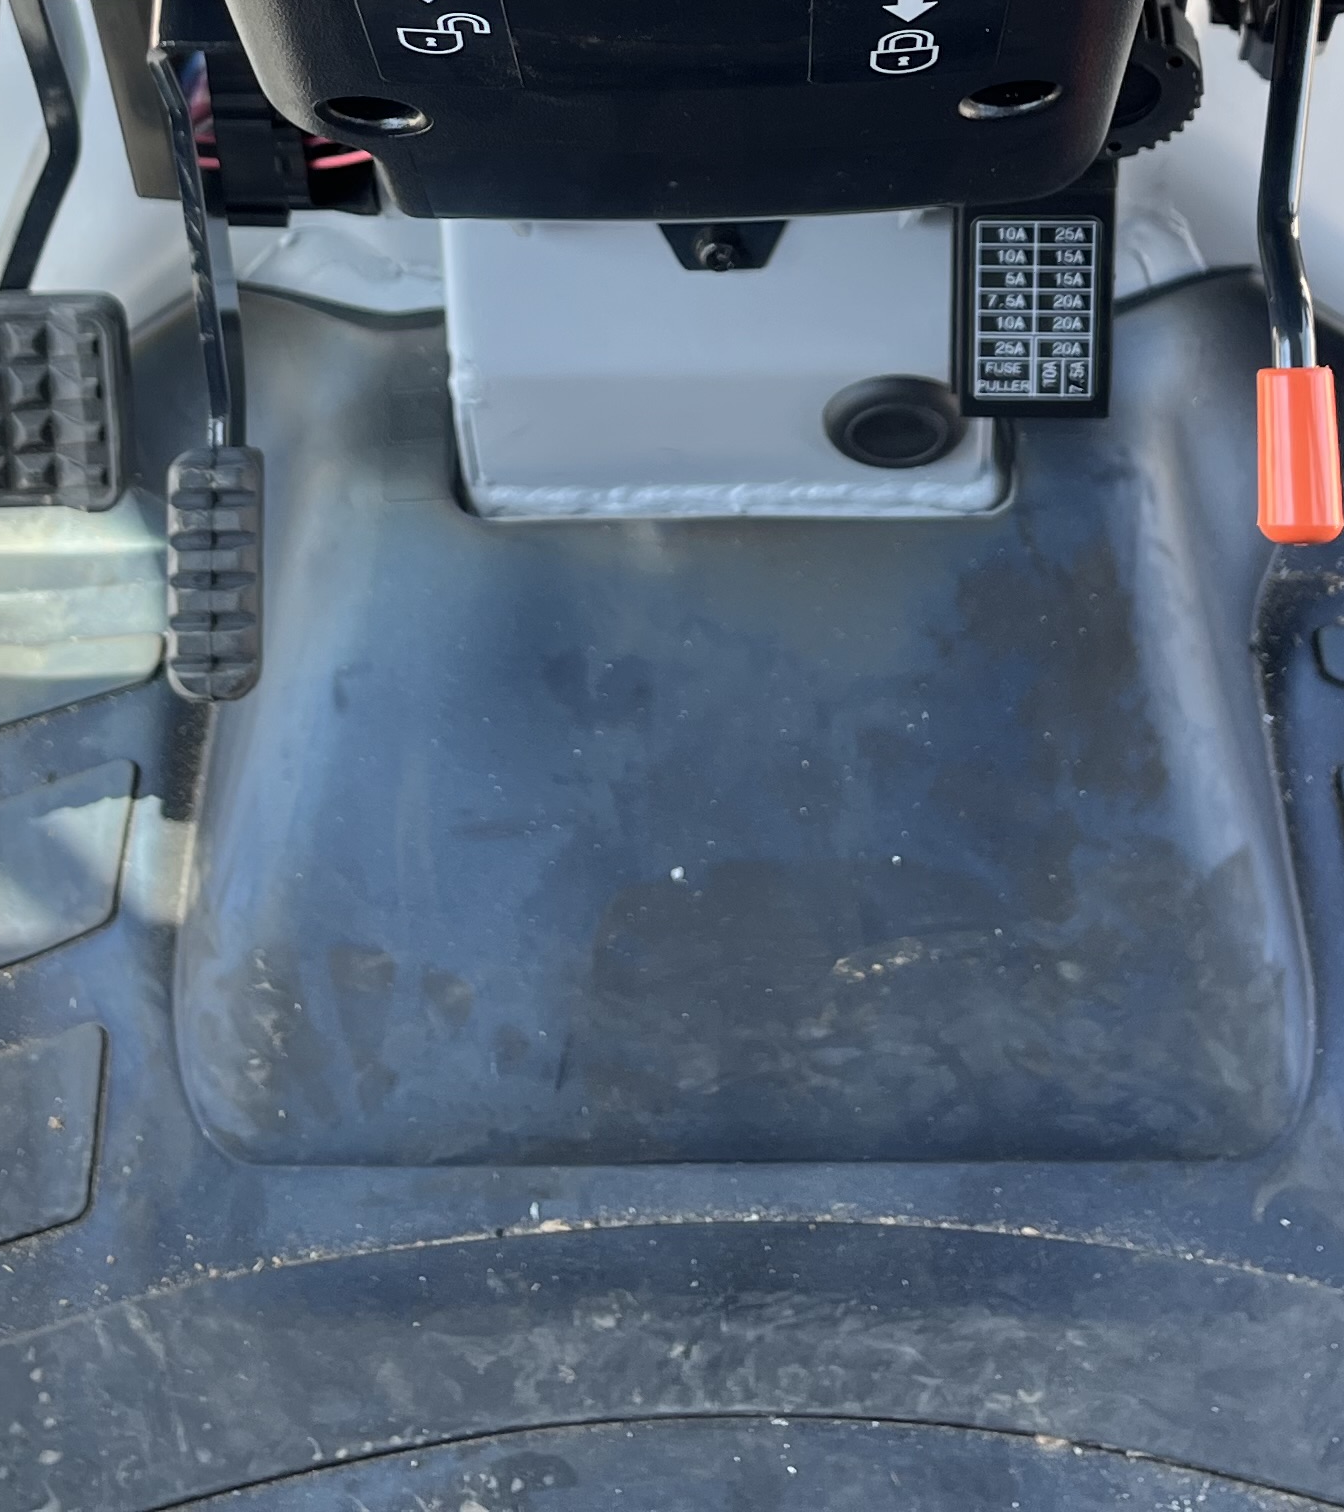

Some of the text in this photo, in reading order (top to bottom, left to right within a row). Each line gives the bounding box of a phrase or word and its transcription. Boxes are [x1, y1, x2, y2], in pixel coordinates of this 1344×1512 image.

[997, 227, 1027, 241] 10A
[1055, 227, 1086, 242] 25A
[997, 250, 1027, 264] 10A
[1055, 250, 1085, 264] 15A
[1005, 272, 1026, 286] 5A
[1054, 272, 1085, 286] 15A
[988, 294, 1026, 309] 7.5A
[1053, 294, 1085, 309] 20A
[996, 316, 1026, 330] 10A
[1052, 316, 1085, 331] 20A
[994, 341, 1026, 356] 25A
[1052, 341, 1083, 356] 20A
[984, 361, 1022, 374] FUSE
[1042, 361, 1058, 387] 10A
[1069, 361, 1085, 393] 7.5A
[978, 379, 1030, 392] PULLER
